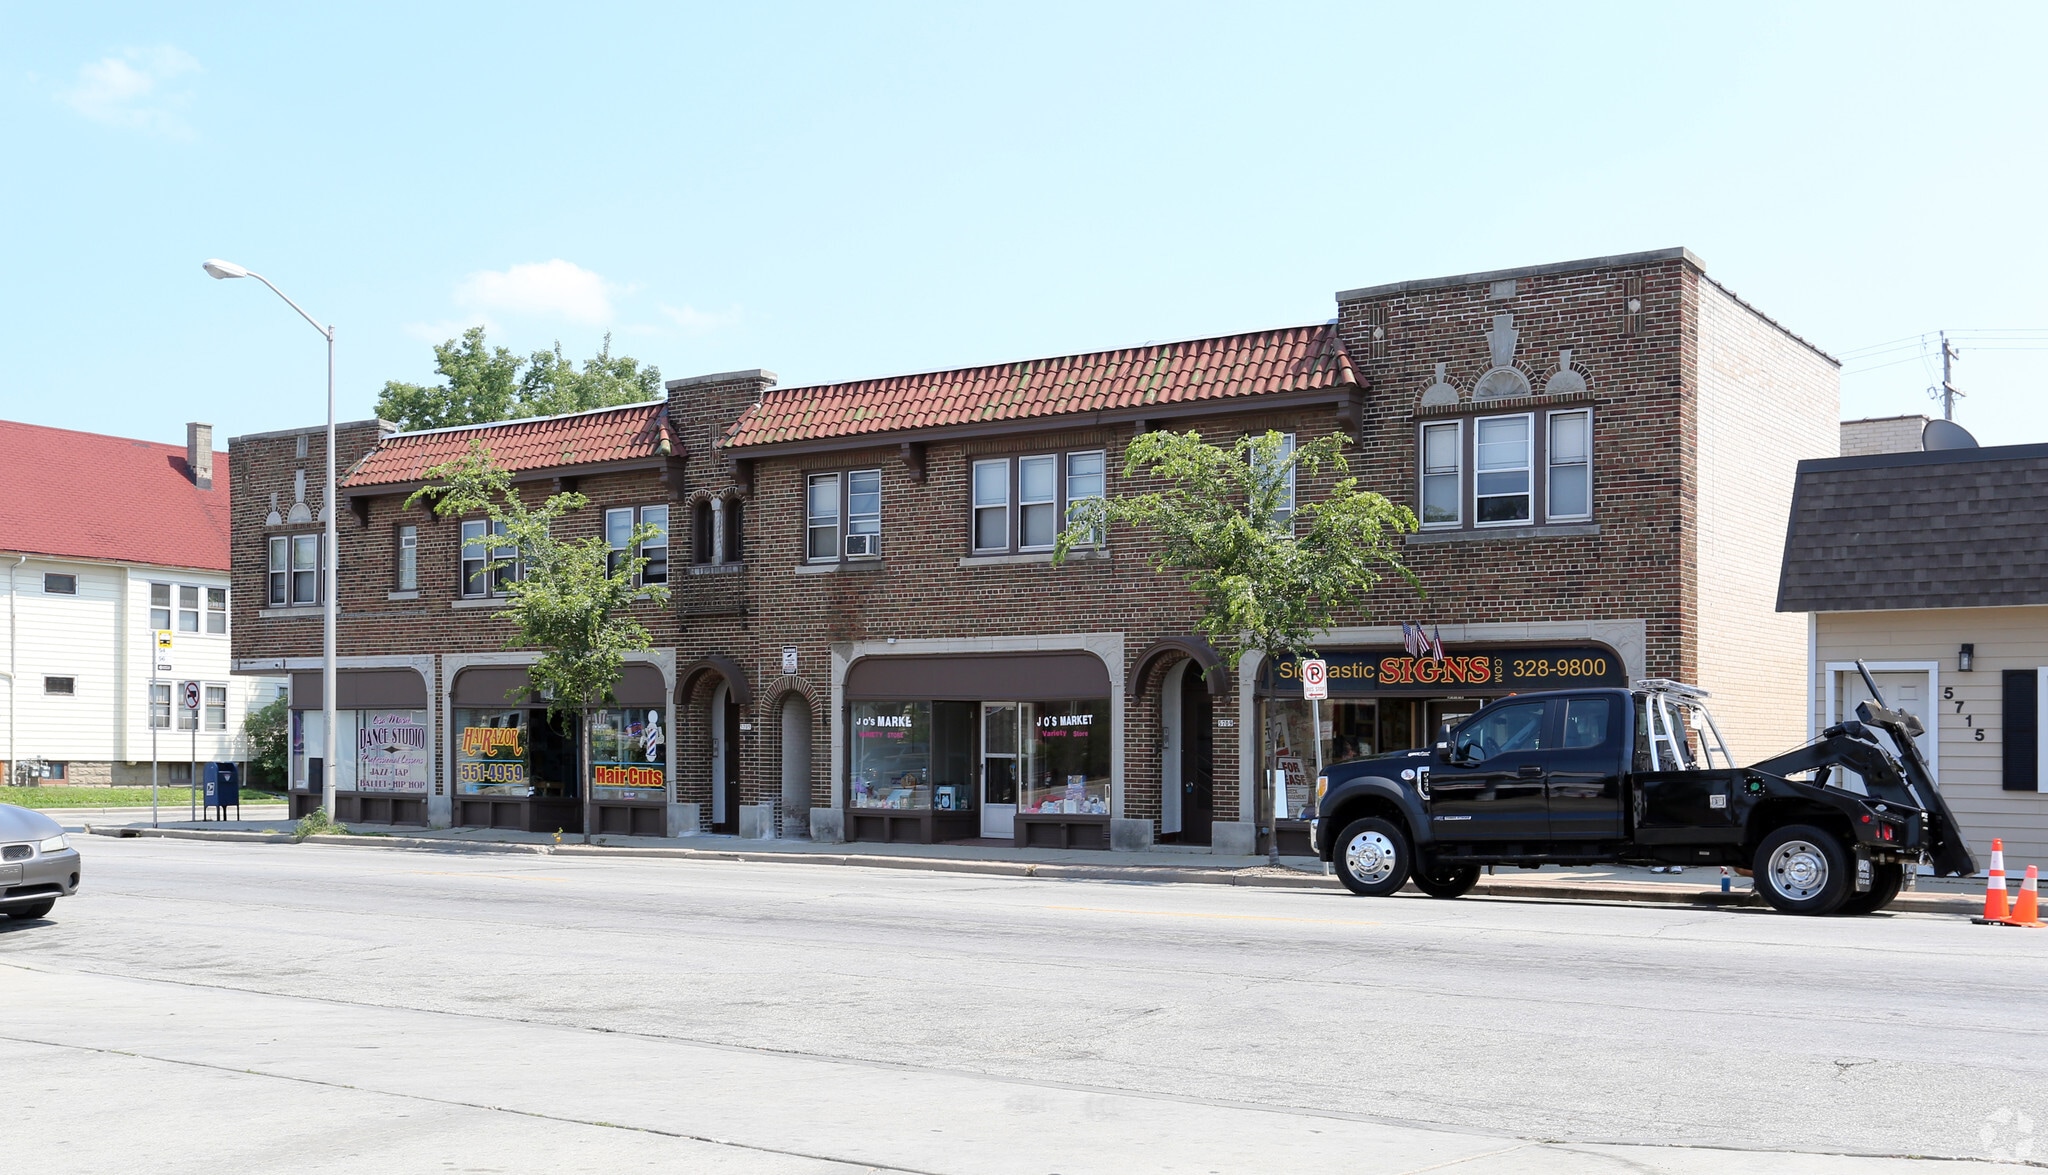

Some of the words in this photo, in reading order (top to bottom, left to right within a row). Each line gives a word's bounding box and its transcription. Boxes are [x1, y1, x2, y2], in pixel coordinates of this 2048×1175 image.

[1379, 656, 1491, 684] SIGNS
[1513, 658, 1607, 677] 328-9800
[1060, 714, 1093, 726] MARKET
[360, 728, 388, 749] DANCE
[391, 728, 425, 749] STUDIO
[401, 755, 424, 764] Lessons
[370, 767, 389, 776] JAZZ
[395, 768, 409, 776] TAP
[461, 763, 524, 783] 551-4959
[1282, 761, 1300, 773] FOR
[595, 766, 627, 786] Hair
[627, 766, 663, 787] Cuts
[1285, 774, 1307, 785] EASE
[360, 779, 387, 788] BALLET
[392, 780, 406, 789] HIP
[408, 781, 425, 789] HOP
